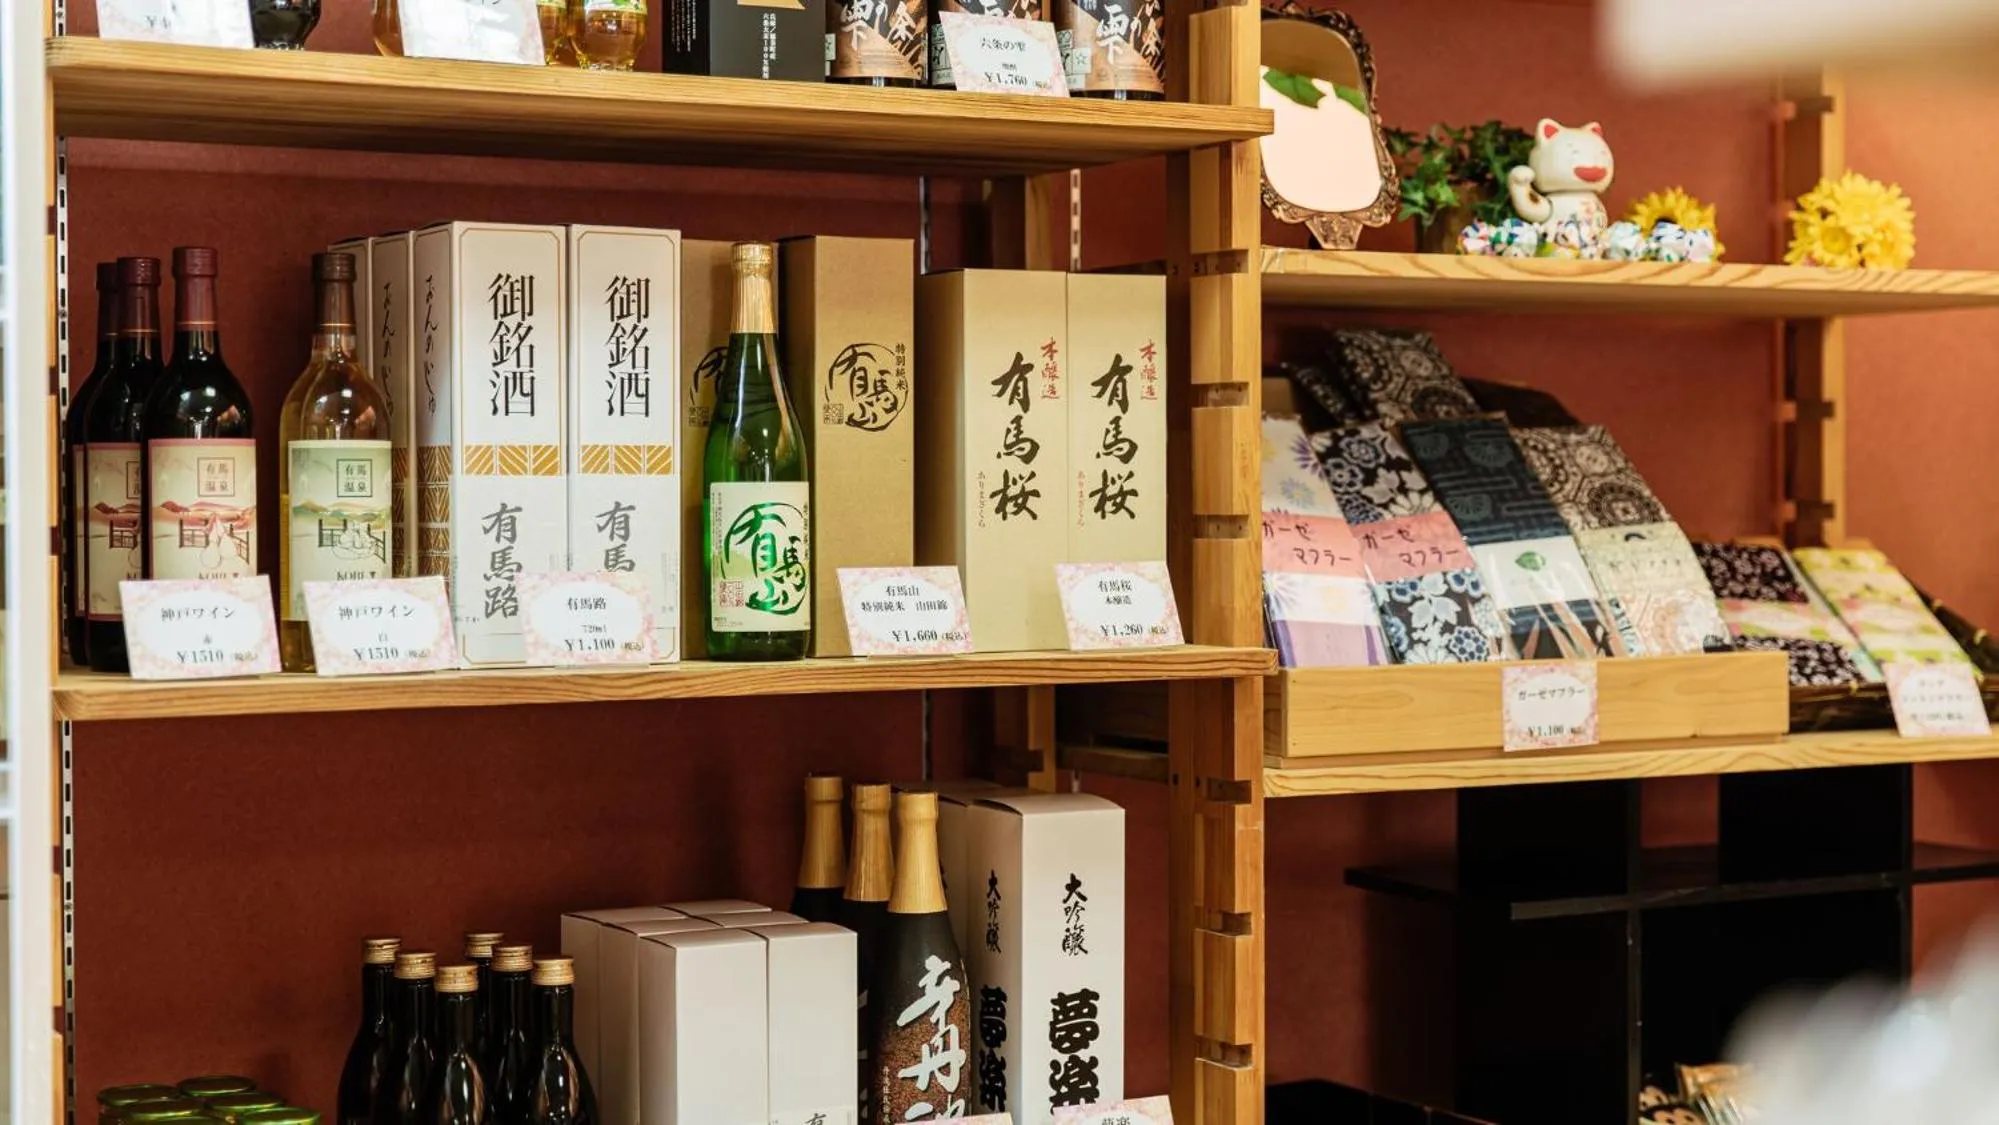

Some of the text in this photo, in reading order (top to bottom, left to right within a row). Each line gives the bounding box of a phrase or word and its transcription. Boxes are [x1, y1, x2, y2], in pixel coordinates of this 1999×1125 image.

[488, 272, 536, 418] 御銘酒
[604, 275, 651, 419] 御銘酒
[1040, 336, 1060, 400] 本醸造
[1139, 338, 1158, 401] 本醸造
[989, 351, 1042, 521] 有馬桜
[1089, 353, 1139, 520] 有馬桜
[1262, 520, 1311, 541] ガーゼ
[1362, 527, 1414, 550] ガーゼ
[482, 502, 524, 620] 有馬路
[722, 502, 806, 616] 有馬山
[1294, 548, 1352, 566] マフラー
[1400, 548, 1459, 568] マフラー
[885, 585, 920, 597] 有馬山
[1098, 579, 1132, 592] 有馬桜
[338, 605, 416, 620] 神戸ワイン
[567, 597, 607, 611] 有馬路
[861, 600, 906, 612] 特別純米
[161, 607, 236, 623] 神戸ワイン
[891, 629, 938, 642] ¥1,660
[1100, 623, 1143, 636] ¥1,260
[565, 638, 615, 652] ¥1,100
[176, 650, 224, 664] ¥1510
[353, 648, 399, 661] ¥1510
[1518, 686, 1585, 701] ガーゼマフラー
[1062, 873, 1088, 957] 大吟醸
